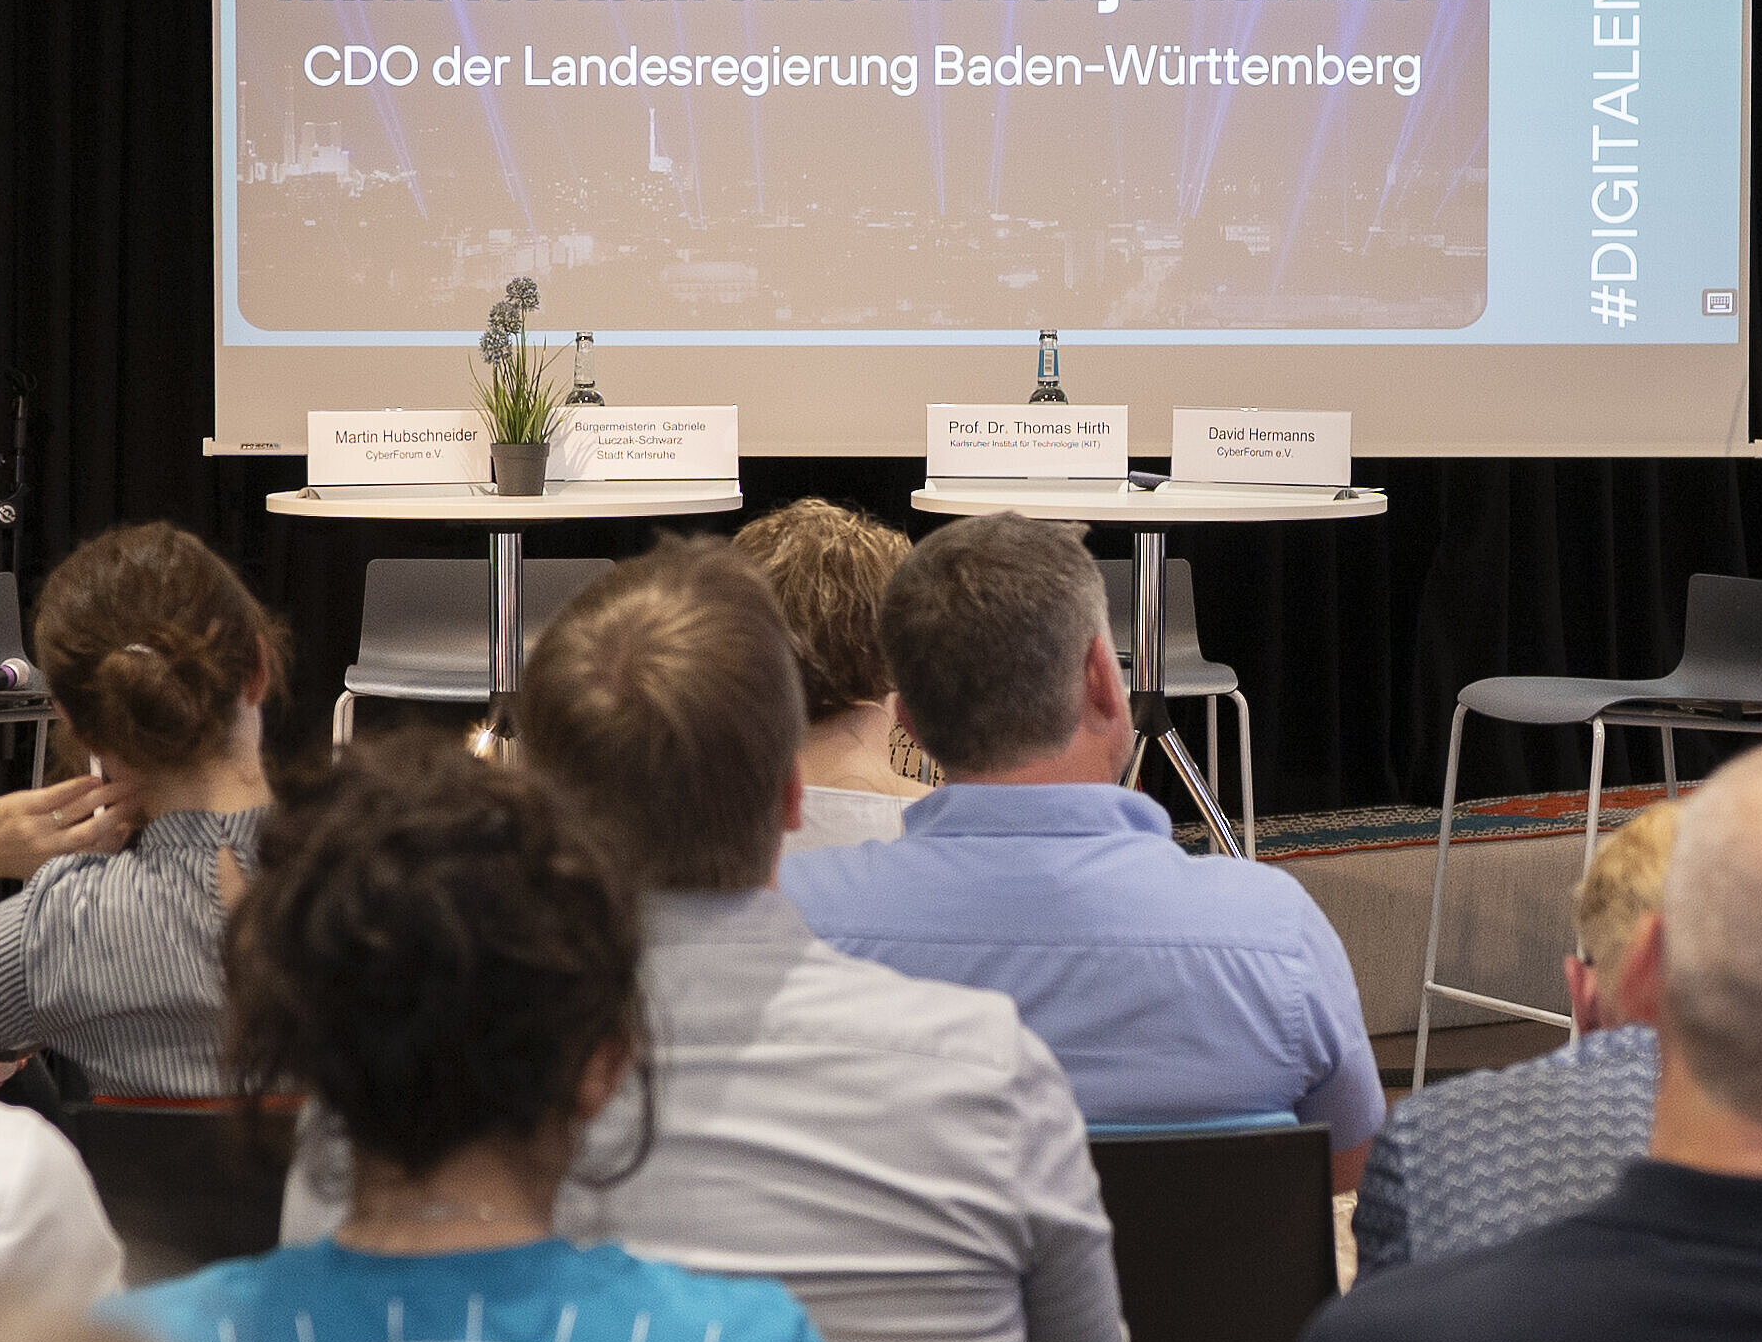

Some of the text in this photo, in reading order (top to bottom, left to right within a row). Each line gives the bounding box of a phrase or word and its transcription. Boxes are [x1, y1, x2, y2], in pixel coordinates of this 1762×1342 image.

[304, 44, 1421, 97] CDO der Landesregierung Baden-Württemberg
[575, 421, 706, 434] Bürgermeisterin Gabriele
[948, 420, 1111, 435] Prof. Dr. Thomas Hirth
[1208, 426, 1316, 442] David Hermanns
[335, 427, 478, 444] Martin Hubschneider
[597, 435, 683, 446] Luczak-Schwarz
[992, 439, 1018, 448] Institut
[1033, 439, 1079, 449] Technologie
[365, 448, 444, 462] CyberForum e.V.
[596, 449, 676, 461] Stadt Karlsruhe
[1217, 445, 1294, 459] CyberForum e.V.
